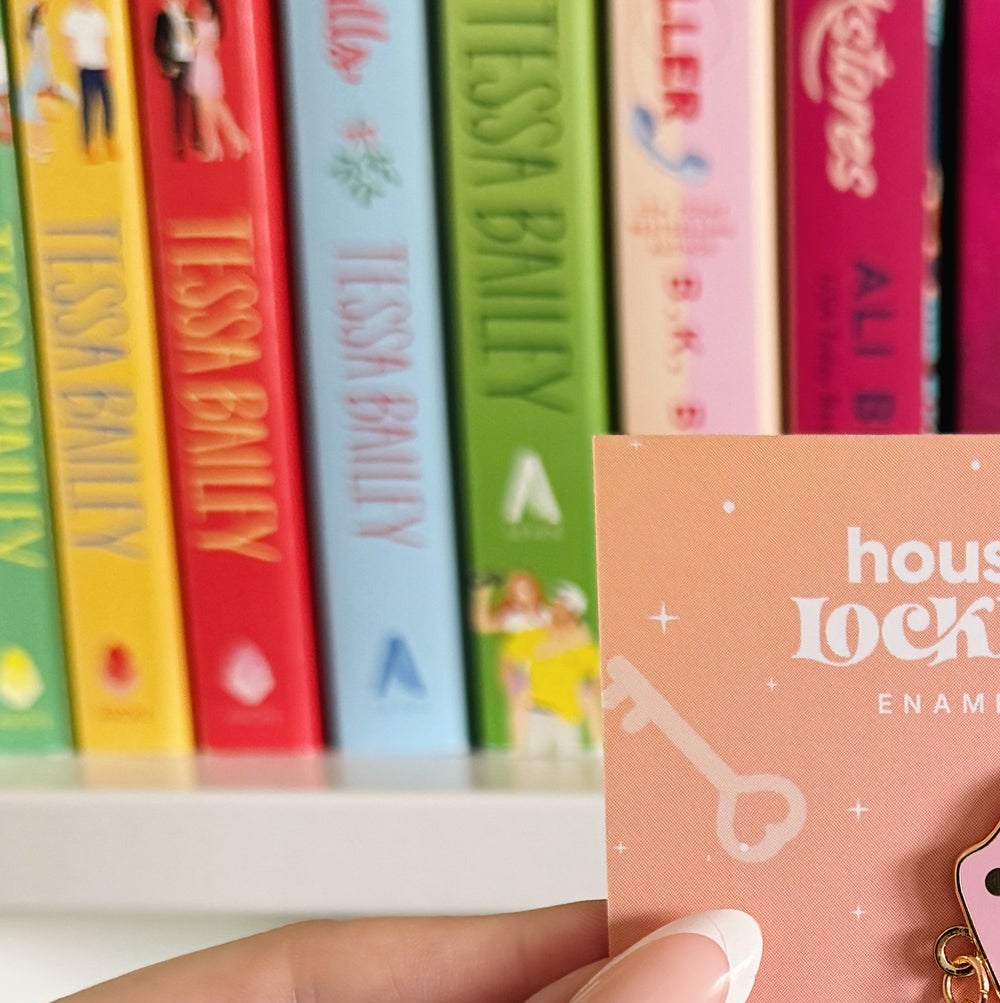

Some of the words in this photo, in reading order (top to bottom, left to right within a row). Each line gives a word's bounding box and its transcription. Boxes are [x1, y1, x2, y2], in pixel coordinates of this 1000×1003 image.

[465, 2, 563, 188] TESSA
[45, 218, 130, 372] TESSA
[168, 215, 262, 374] TESSA
[335, 243, 413, 380] TESSA
[472, 206, 574, 415] BAILEY
[850, 259, 895, 357] ALI
[58, 380, 149, 562] BAILEY
[181, 379, 282, 563] BAILEY
[344, 388, 425, 549] BAILEY
